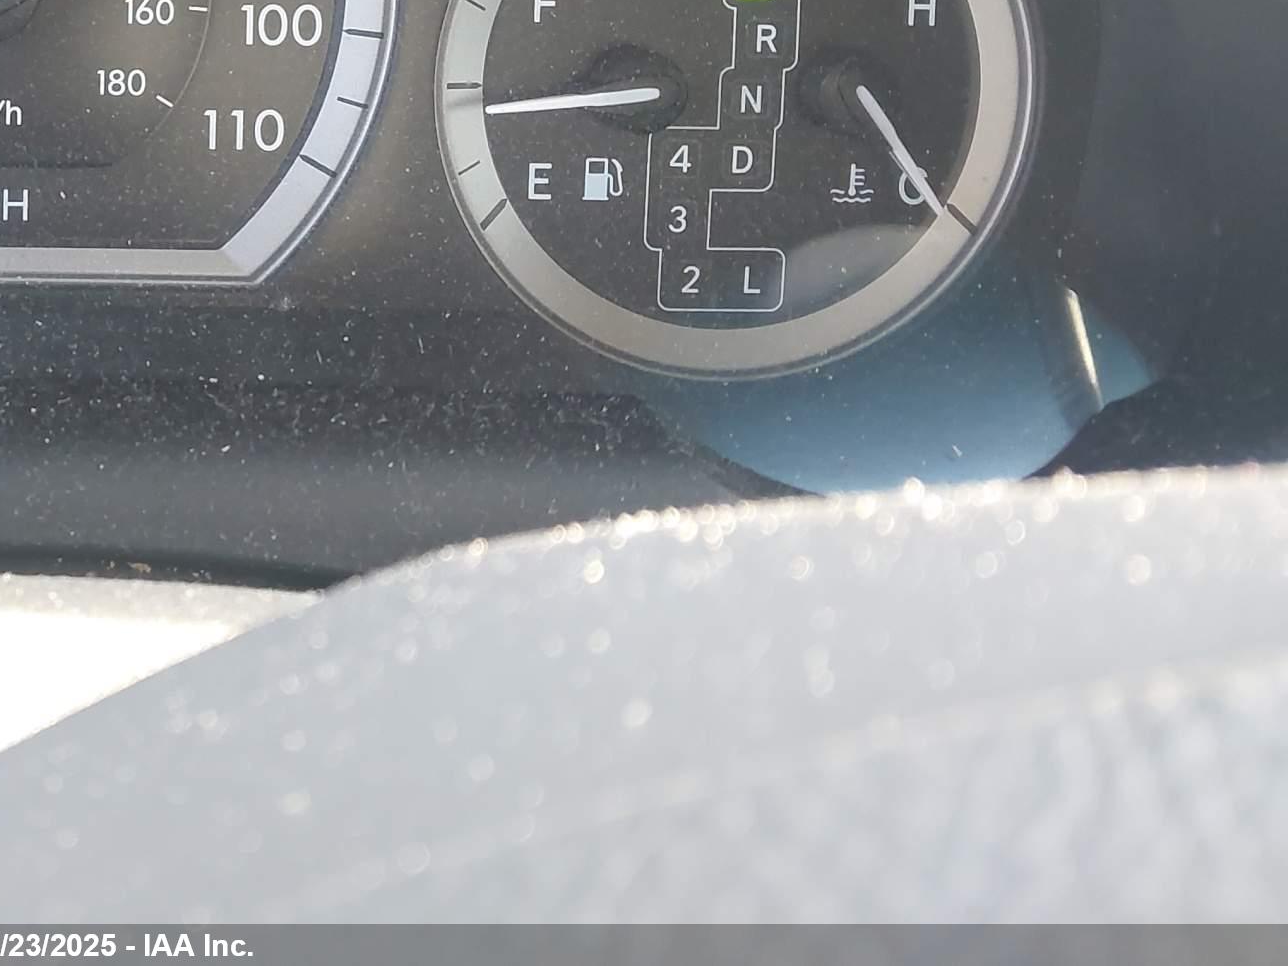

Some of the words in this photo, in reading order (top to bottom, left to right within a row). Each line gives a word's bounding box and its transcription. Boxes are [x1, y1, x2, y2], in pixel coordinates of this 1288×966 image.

[241, 4, 322, 46] 100
[757, 25, 776, 52] R
[97, 70, 145, 96] 180
[741, 86, 762, 113] N
[204, 110, 284, 151] 110
[670, 145, 691, 172] 4
[732, 146, 752, 173] D
[528, 163, 552, 199] E
[669, 206, 686, 232] 3
[682, 266, 699, 293] 2
[744, 266, 760, 293] L
